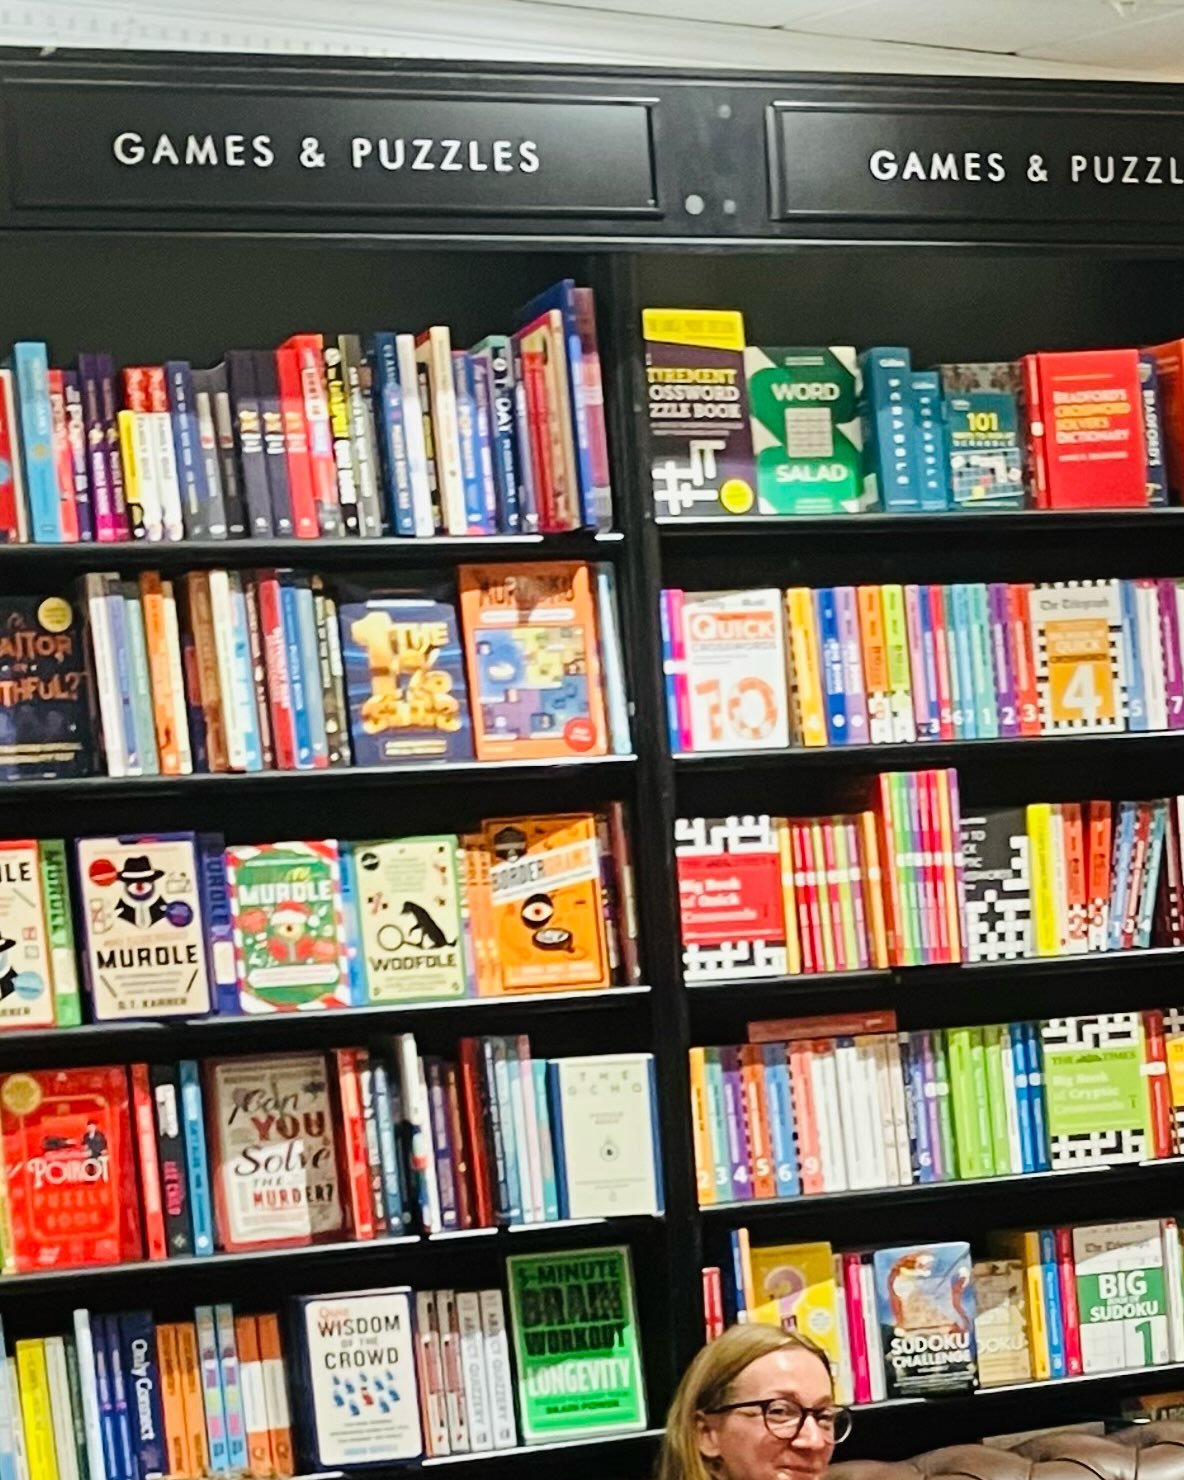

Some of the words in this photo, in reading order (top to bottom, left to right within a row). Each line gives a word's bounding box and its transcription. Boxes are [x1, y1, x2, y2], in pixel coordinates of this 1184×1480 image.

[113, 133, 275, 167] GAMES
[299, 138, 326, 168] &
[352, 138, 541, 173] PUZZLES
[868, 149, 1006, 183] GAMES
[1026, 154, 1050, 183] &
[771, 382, 841, 402] WORD
[965, 412, 999, 432] 101
[775, 463, 848, 484] SALAD
[1061, 663, 1103, 721] 4
[695, 677, 778, 741] 10
[1002, 706, 1016, 726] 2
[1023, 703, 1035, 723] 3
[1170, 695, 1184, 715] 7
[239, 879, 332, 906] MURDLE
[97, 944, 199, 969] MURDLE
[1102, 1050, 1137, 1062] TIMES
[250, 1111, 325, 1142] YOU
[234, 1140, 330, 1177] Solve
[756, 1157, 769, 1177] 5
[804, 1156, 819, 1175] 9
[27, 1156, 110, 1190] POIROT
[732, 1164, 748, 1184] 4
[778, 1163, 793, 1182] 6
[253, 1183, 334, 1207] MURDER?
[517, 1257, 621, 1286] 5-MINUTE
[1097, 1269, 1148, 1301] BIG
[1089, 1300, 1160, 1323] SUDOKU
[317, 1314, 401, 1338] WISDOM
[359, 1336, 378, 1346] THE
[524, 1325, 626, 1357] WORKOUT
[890, 1333, 970, 1356] SUDOKU
[1134, 1320, 1152, 1367] 1
[324, 1346, 400, 1371] CROWD
[892, 1350, 972, 1370] CHALLENGE
[527, 1358, 631, 1398] LONGEVITY
